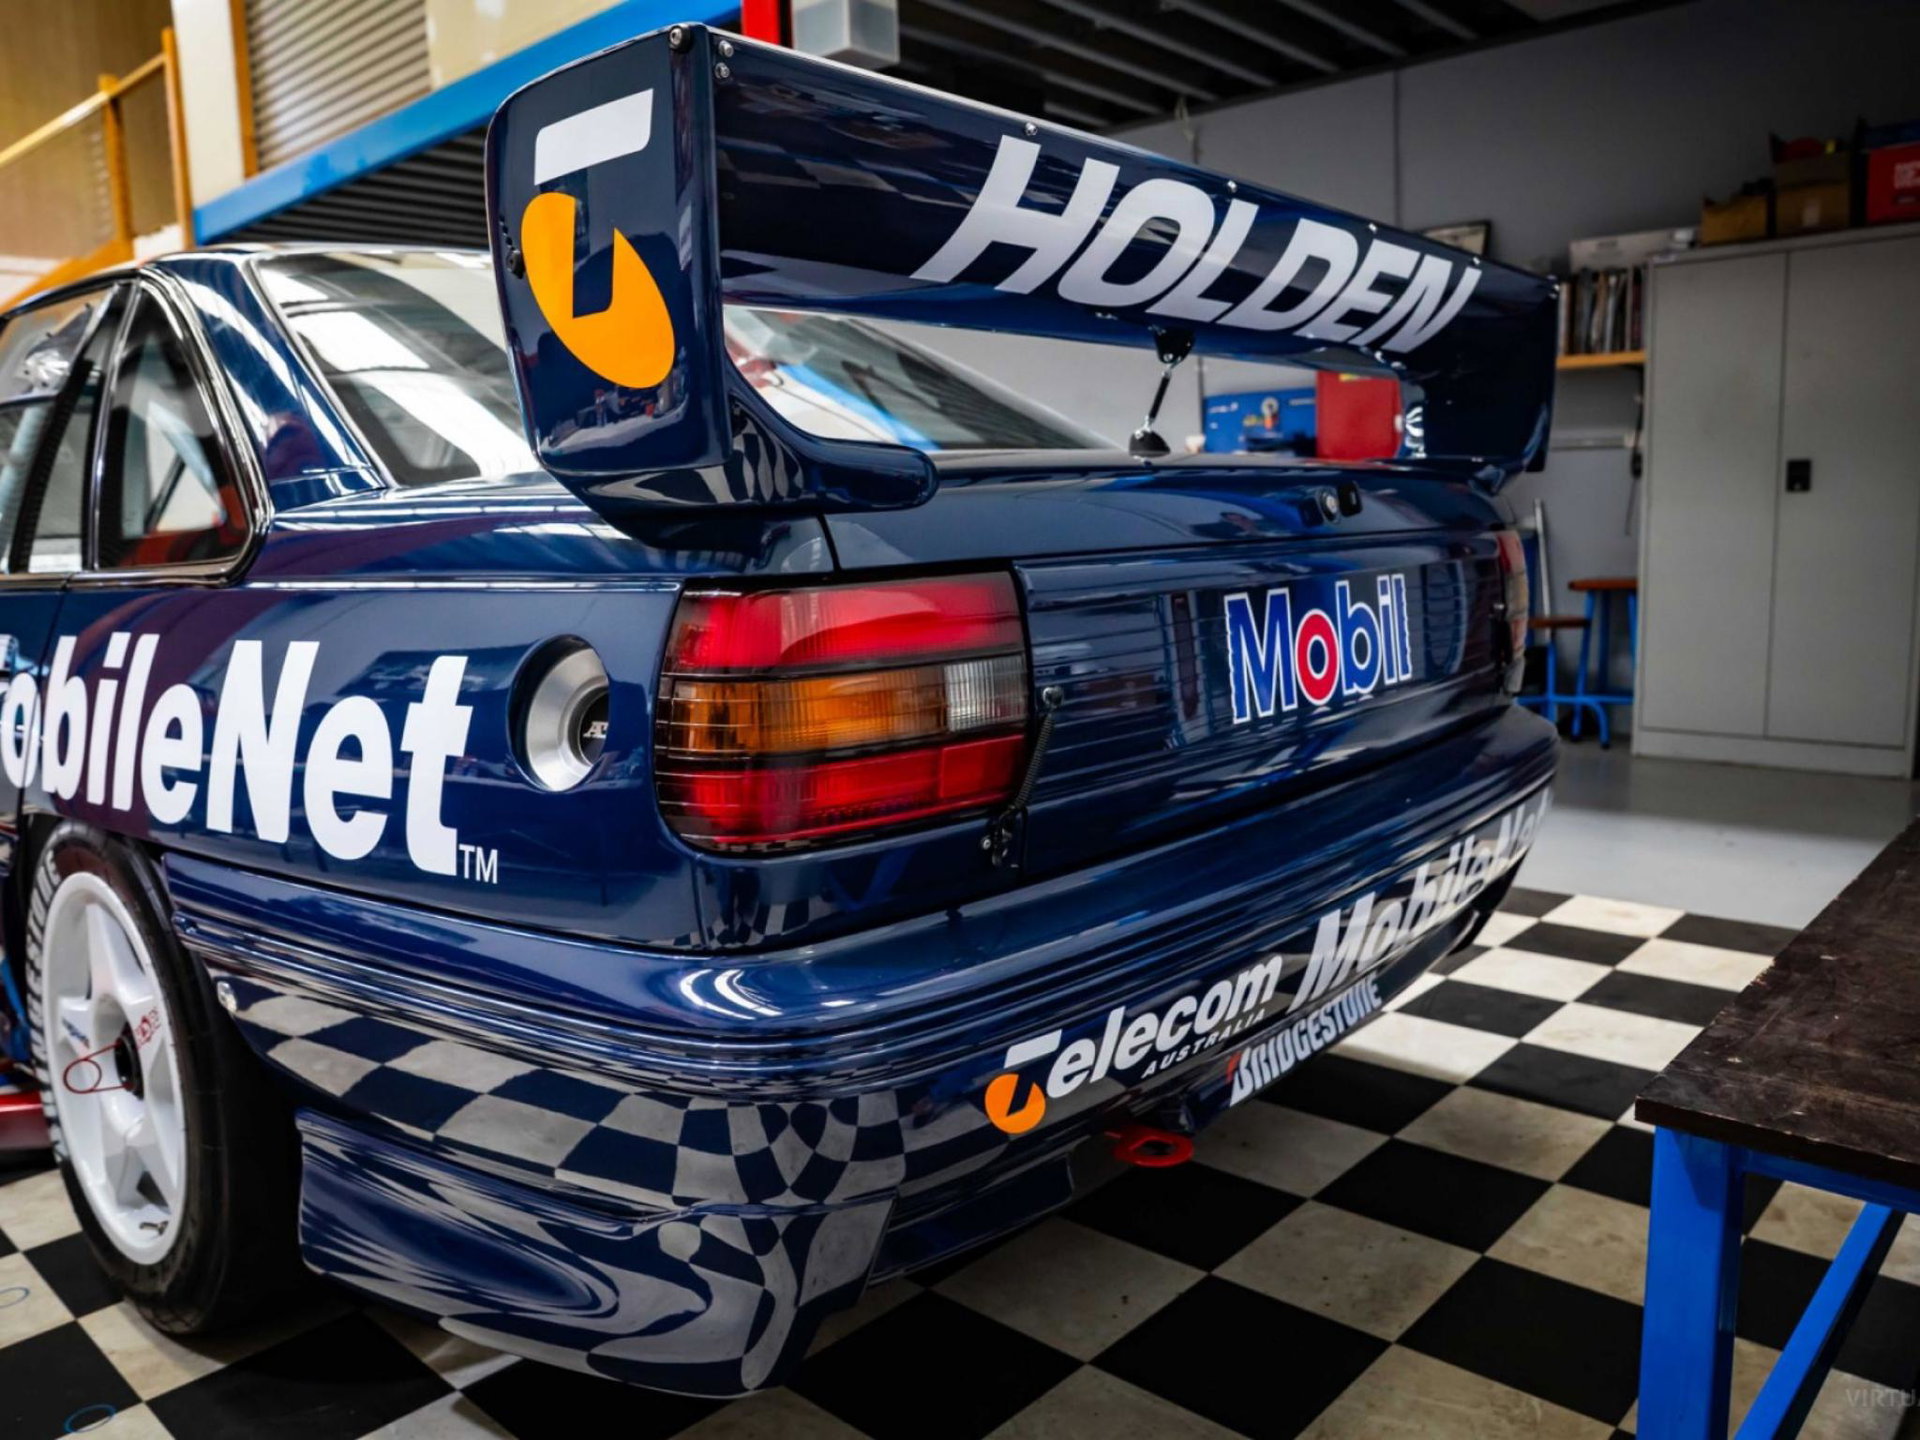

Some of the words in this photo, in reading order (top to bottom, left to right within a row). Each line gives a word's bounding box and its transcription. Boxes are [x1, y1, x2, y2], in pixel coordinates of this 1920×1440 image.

[910, 134, 1482, 354] HOLDEN
[1224, 573, 1412, 725] Mobil
[0, 631, 473, 876] obileNet
[459, 843, 498, 884] TM
[985, 956, 1282, 1134] Telecom
[1142, 1009, 1265, 1078] AUSTRALIA
[1225, 971, 1382, 1107] BRIDGESTONE
